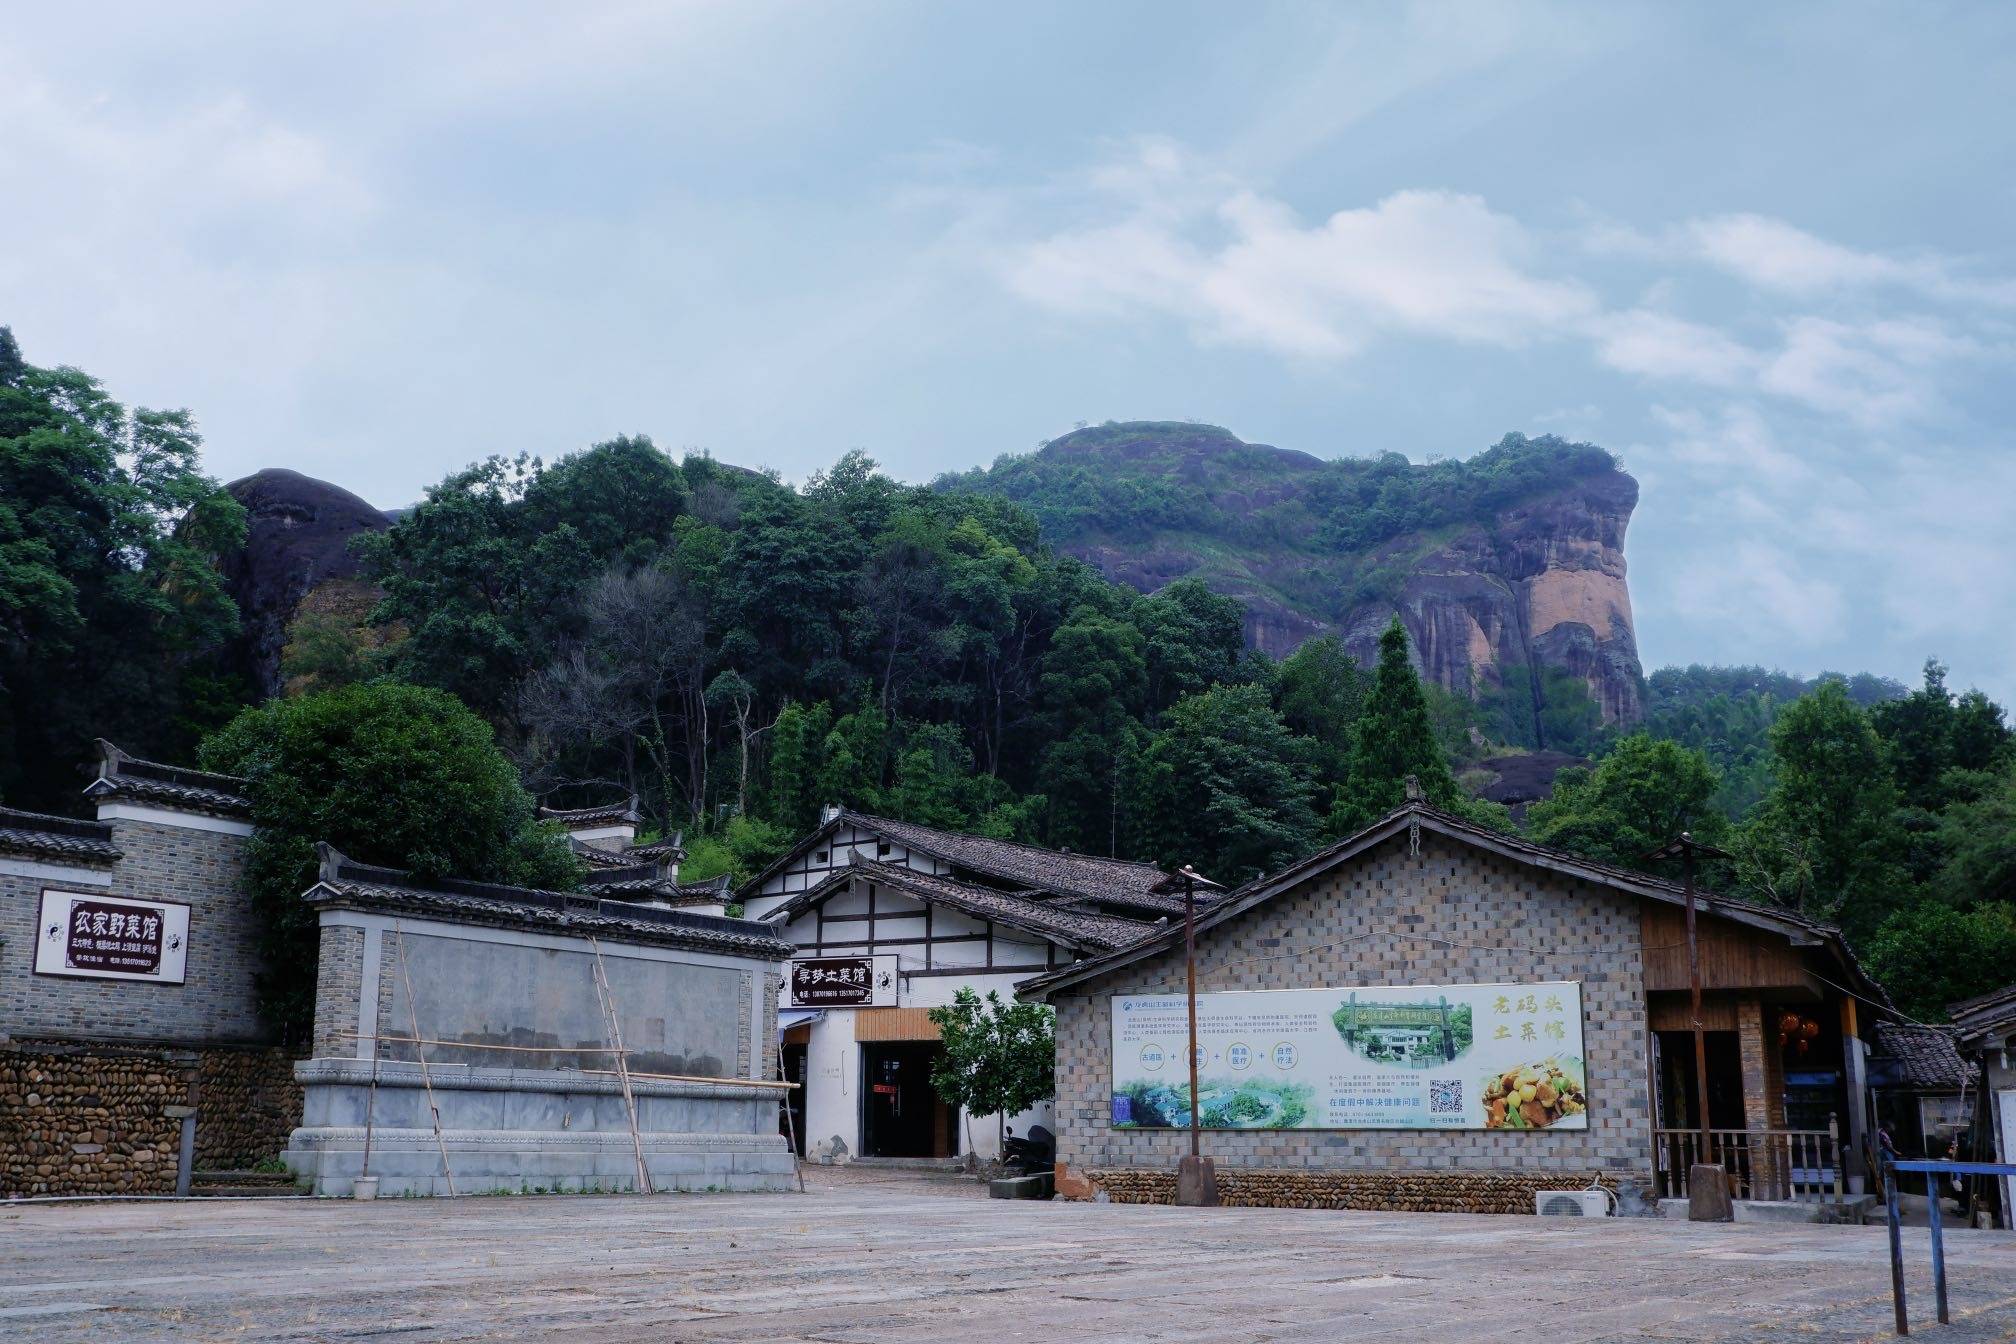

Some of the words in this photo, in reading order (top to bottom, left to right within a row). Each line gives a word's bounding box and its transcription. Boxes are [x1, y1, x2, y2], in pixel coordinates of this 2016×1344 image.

[75, 910, 158, 940] 农家野菜馆
[798, 967, 866, 985] 寻梦土菜馆
[1492, 993, 1563, 1014] 老码头
[1231, 1047, 1247, 1056] 精准
[1277, 1046, 1293, 1055] 自然
[1141, 1052, 1163, 1062] 古道医
[1231, 1056, 1247, 1065] 医疗
[1277, 1056, 1293, 1065] 疗法
[1329, 1097, 1421, 1107] 在度假中解决健康问题
